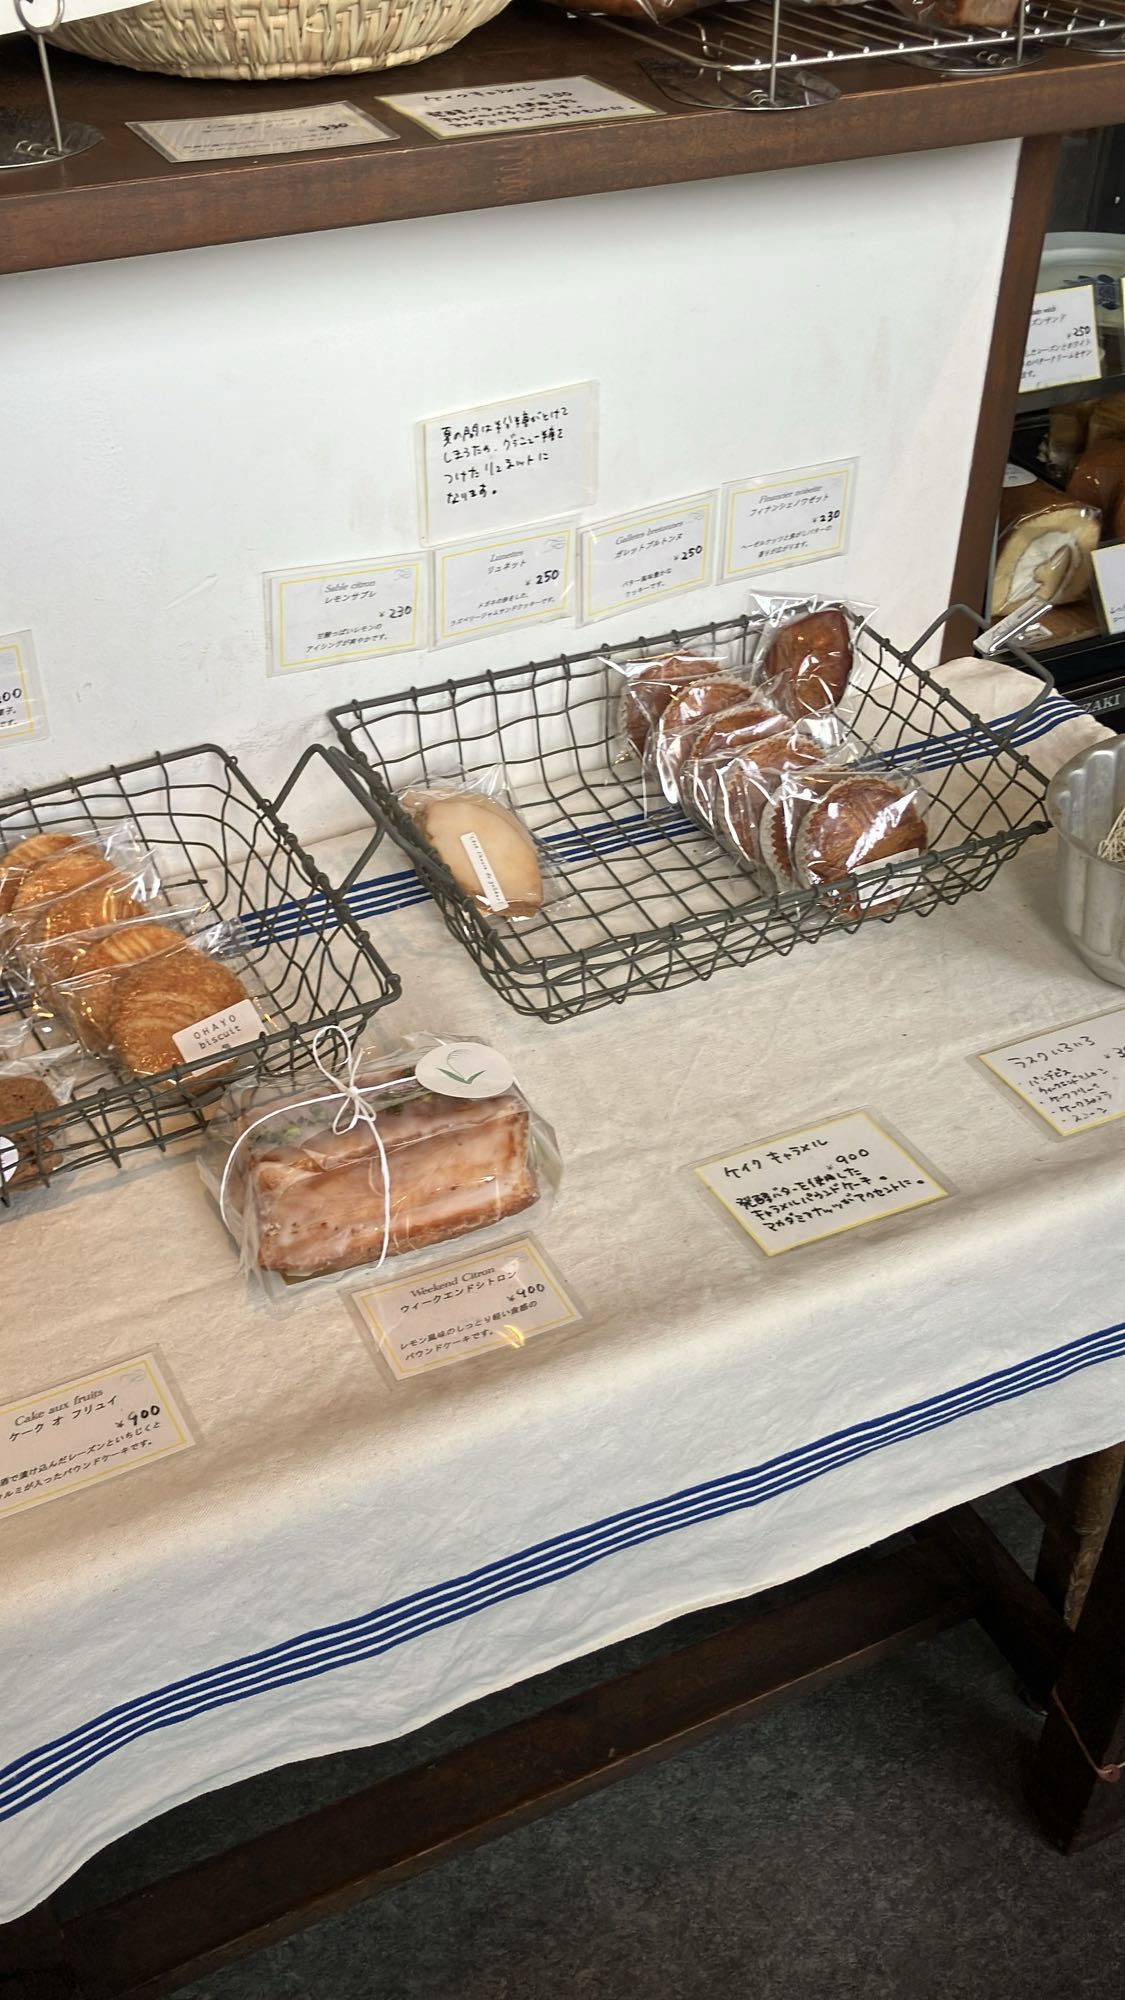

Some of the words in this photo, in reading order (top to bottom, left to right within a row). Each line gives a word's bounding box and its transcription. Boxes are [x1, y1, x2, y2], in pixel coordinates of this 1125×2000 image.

[324, 590, 377, 604] レモンサブレ
[378, 605, 413, 619] ¥230
[0, 688, 22, 703] 00
[193, 1014, 236, 1039] OHAYO
[199, 1026, 241, 1050] biscuit
[724, 1158, 762, 1179] ケイク
[766, 1139, 829, 1164] キャラメル
[400, 1271, 517, 1313] ウィークエンドシトロン
[411, 1277, 458, 1297] Weekend
[461, 1267, 495, 1283] Citron
[400, 1300, 538, 1351] レモン風味のしっとり軽い食感の
[405, 1329, 494, 1361] パウンドケーキです。
[9, 1423, 44, 1442] ケーク
[52, 1416, 64, 1426] オ
[72, 1395, 117, 1419] フリュイ
[14, 1411, 45, 1427] Cake
[48, 1402, 69, 1414] aux
[73, 1389, 103, 1406] fruits
[115, 1404, 160, 1428] ¥900
[0, 1439, 152, 1499] ルミが入ったパウンドケーキです。
